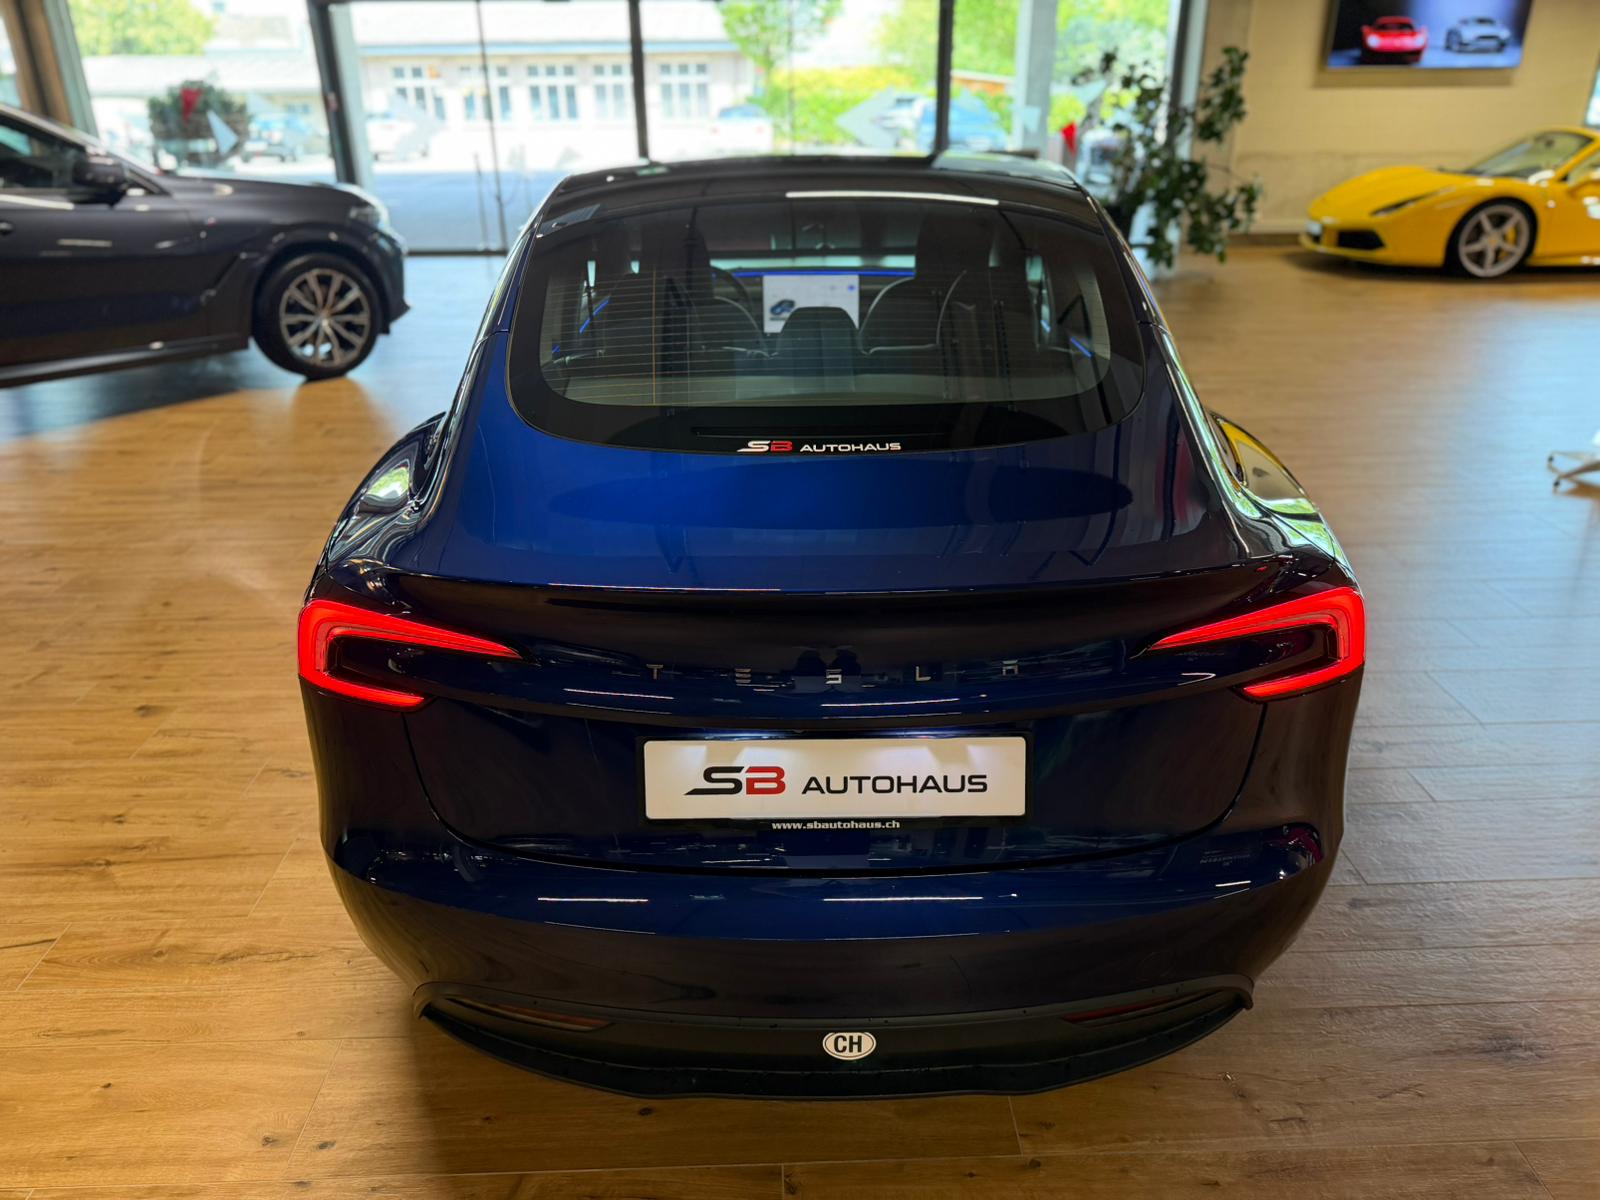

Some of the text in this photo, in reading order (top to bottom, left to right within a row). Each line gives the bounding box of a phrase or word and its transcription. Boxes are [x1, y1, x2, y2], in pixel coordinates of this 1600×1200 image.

[737, 440, 902, 453] SB AUTOHAUS
[646, 659, 1019, 685] TESLA
[684, 766, 988, 796] SB AUTOHAUS
[771, 819, 901, 830] www.sbautohaus.ch
[833, 1035, 863, 1053] CH
